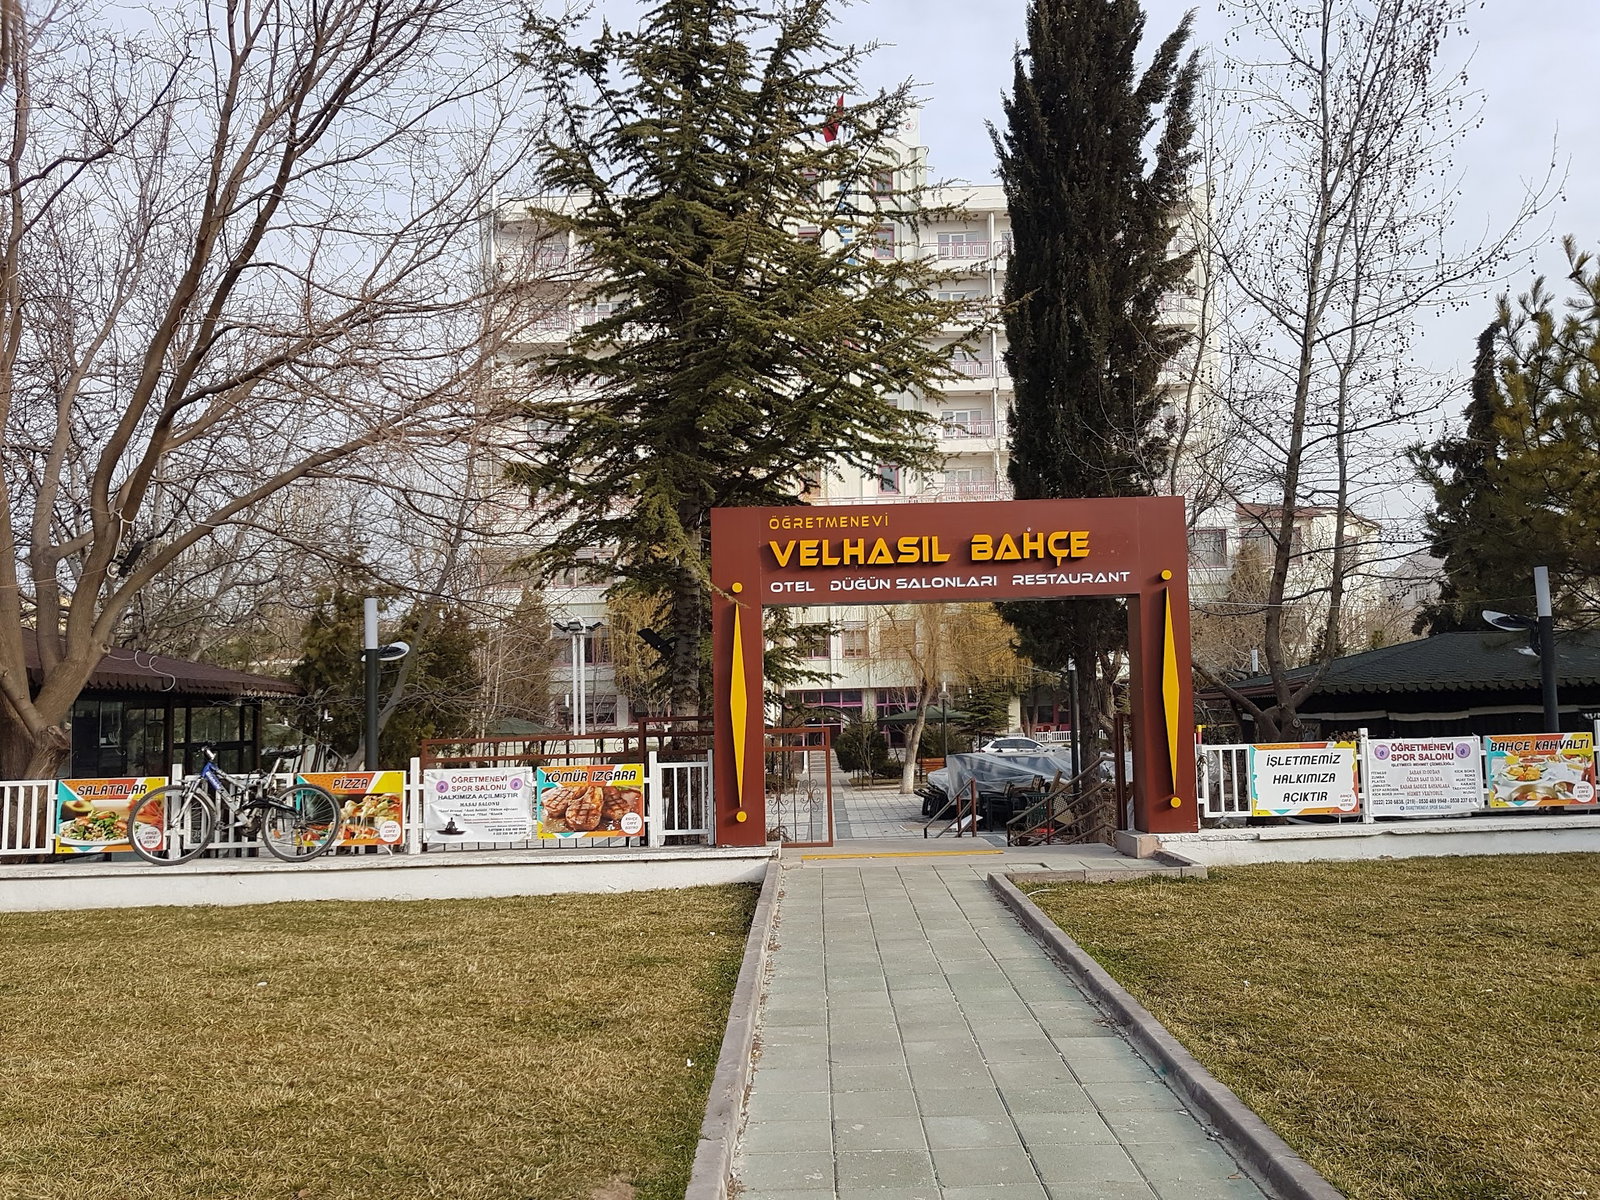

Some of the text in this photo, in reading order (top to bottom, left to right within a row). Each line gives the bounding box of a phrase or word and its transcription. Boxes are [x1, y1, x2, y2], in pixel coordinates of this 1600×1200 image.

[769, 513, 889, 530] ÖĞRETMENEVİ
[769, 531, 1090, 568] VELHASIL BAHÇE
[770, 572, 1130, 592] OTEL DÜĞÜN SALONLARI RESTAURANT
[1391, 742, 1454, 752] ÖĞRETMENEVİ
[1490, 739, 1589, 753] BAHÇE KAHVALTI
[1266, 752, 1341, 767] İŞLETMEMİZ
[1419, 752, 1454, 760] SALONU
[452, 775, 508, 784] ÖĞRETMENEVİ
[545, 770, 636, 782] KÖMÜR IZGARA
[1273, 773, 1336, 784] HALKIMIZA
[333, 776, 368, 789] PİZZA
[77, 784, 148, 796] SALATALAR
[1283, 792, 1328, 804] AÇIKTIR
